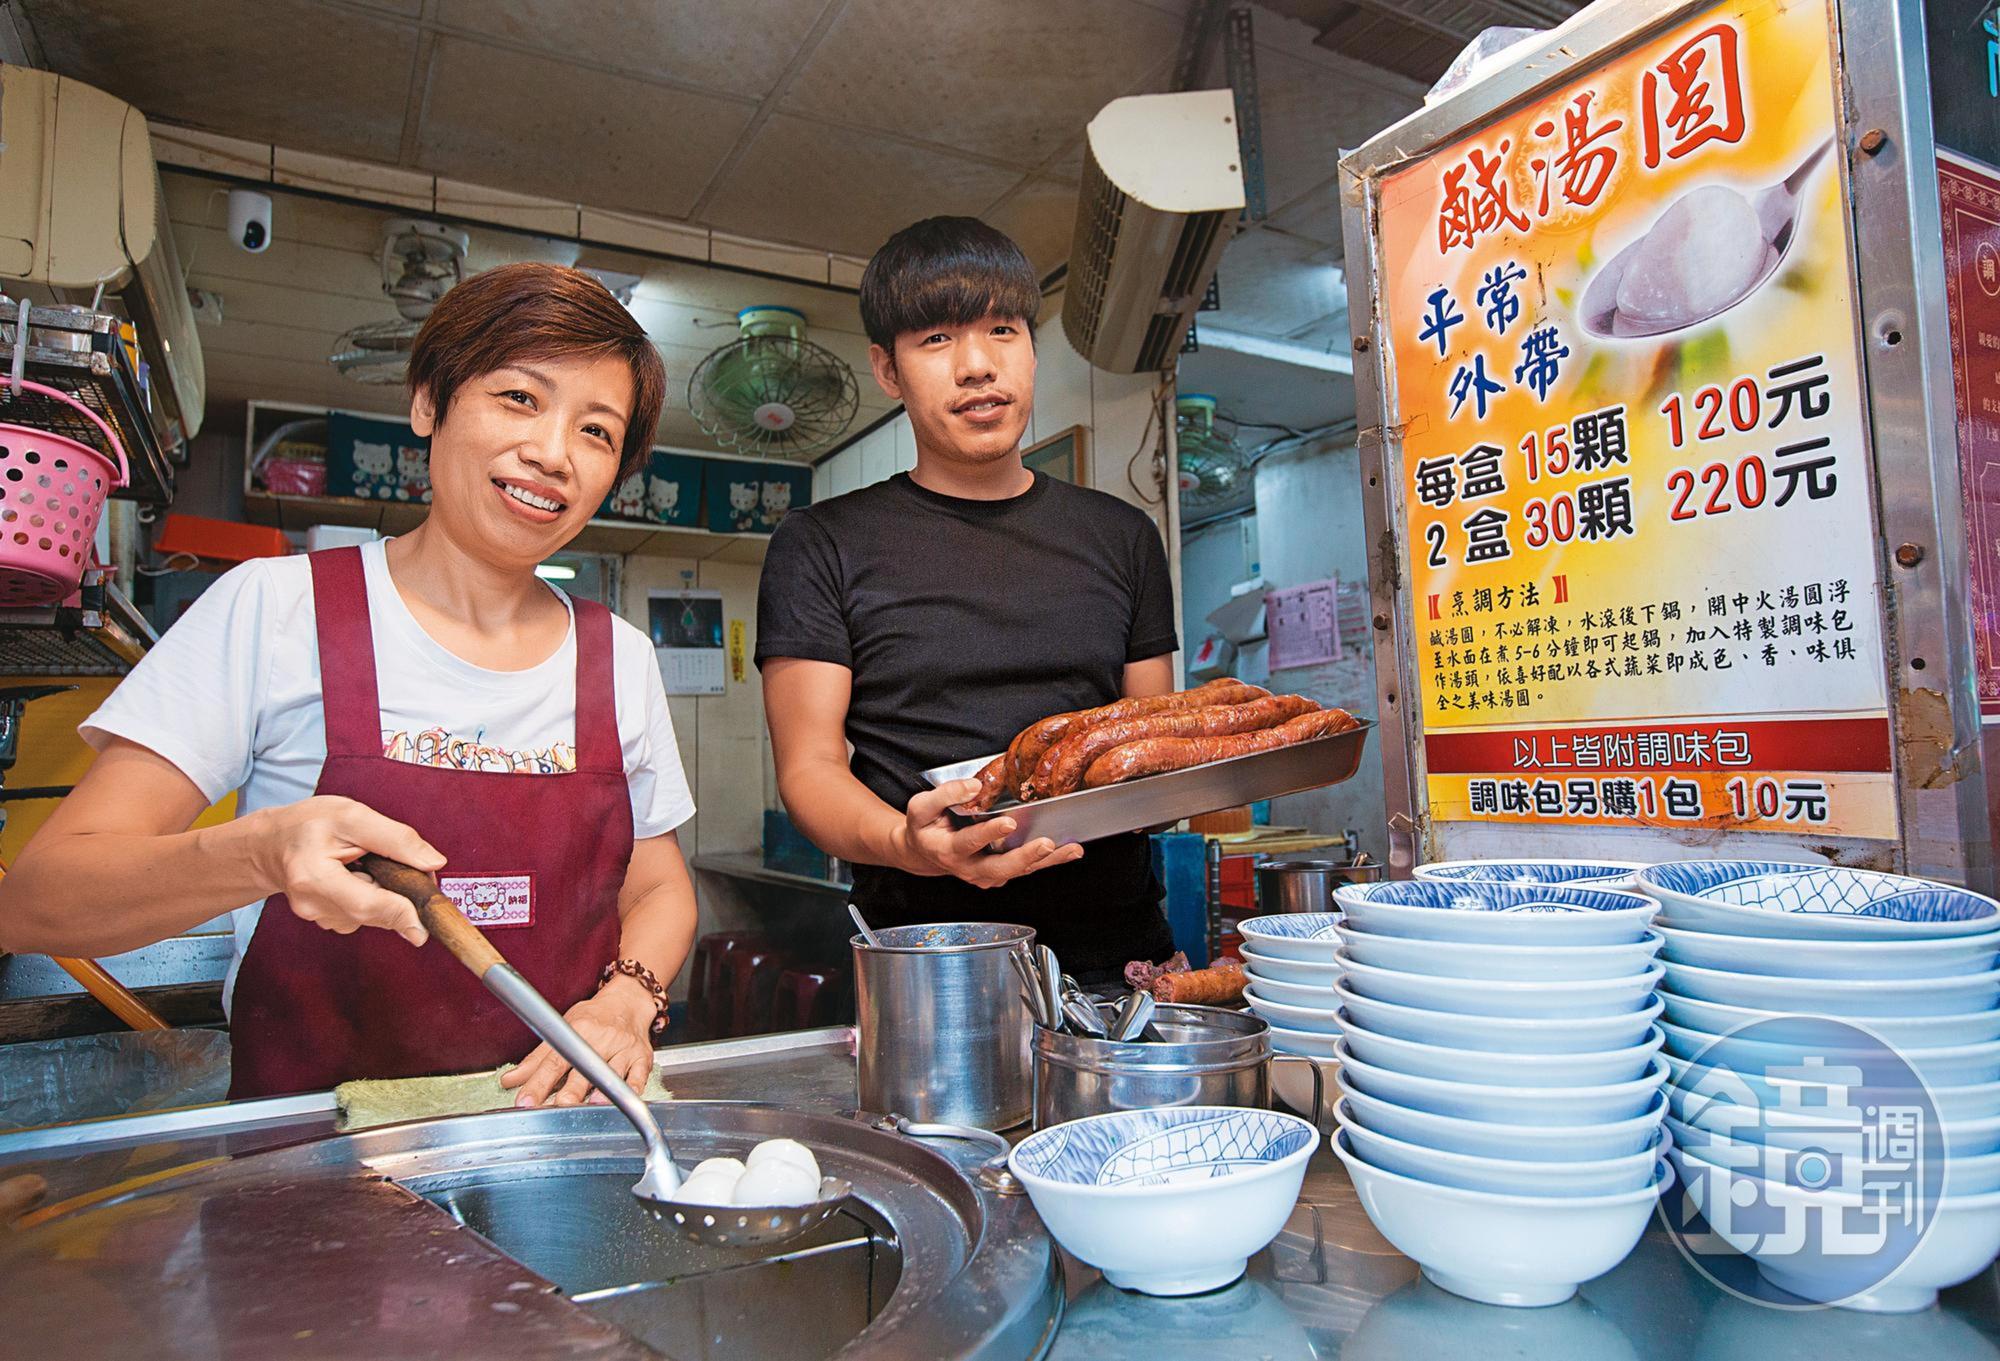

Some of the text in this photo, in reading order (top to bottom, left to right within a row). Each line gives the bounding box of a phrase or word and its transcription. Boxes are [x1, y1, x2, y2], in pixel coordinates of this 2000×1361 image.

[1438, 23, 1747, 256] 鹹湯圓
[1417, 261, 1528, 357] 平常
[1448, 326, 1570, 421] 外帶
[1660, 354, 1831, 449] 120元
[1667, 436, 1838, 523] 220元
[1512, 730, 1754, 769] 以上皆附調味包
